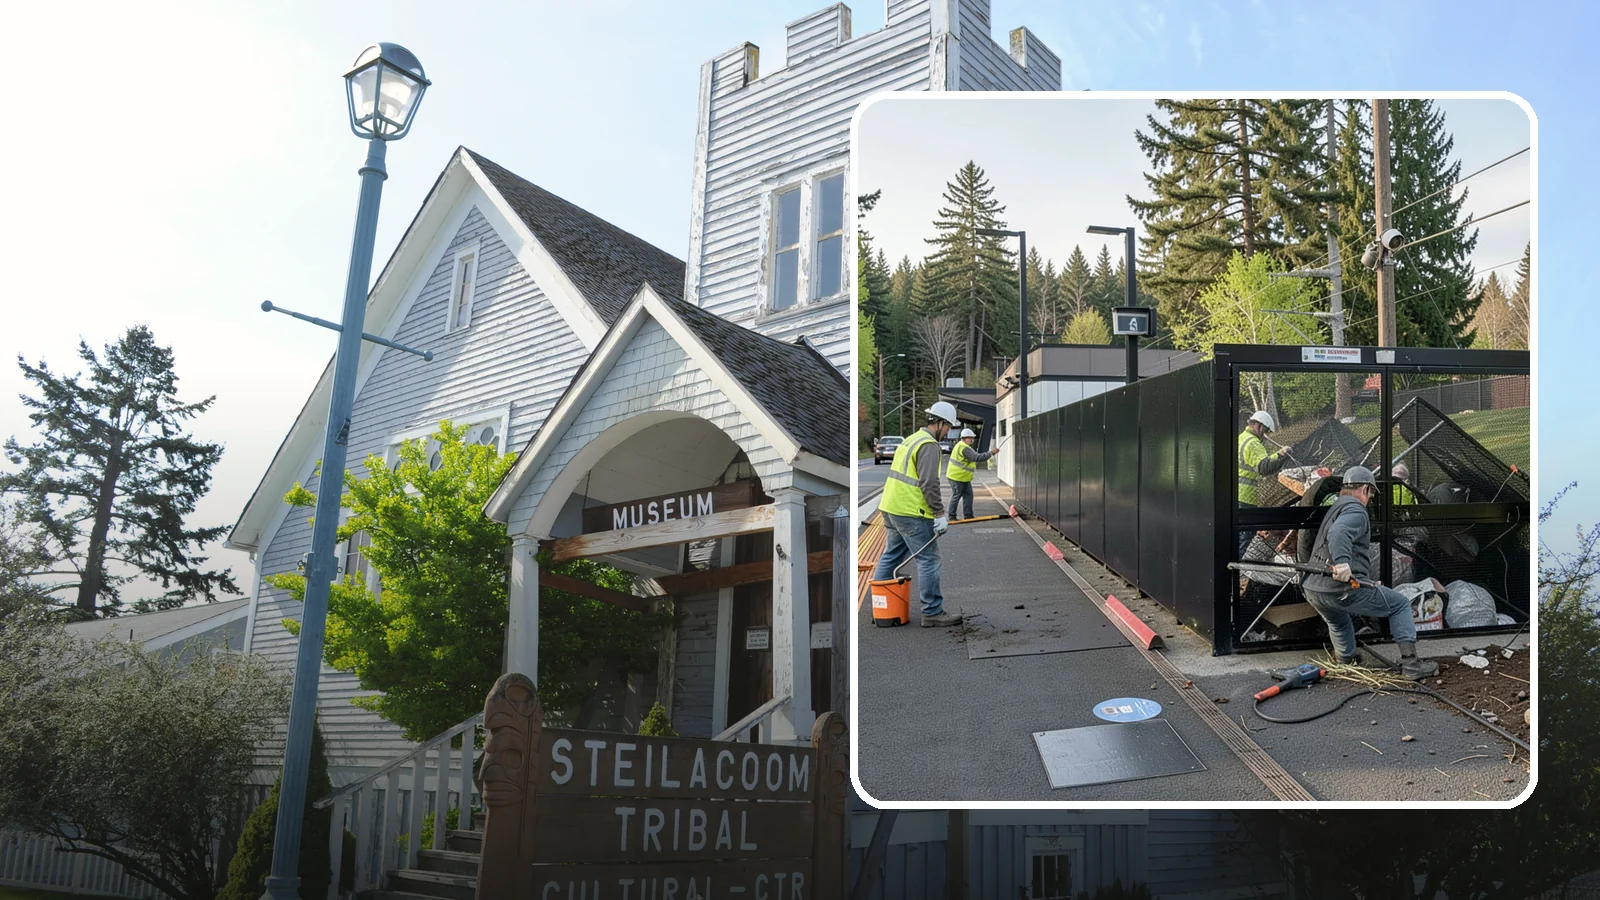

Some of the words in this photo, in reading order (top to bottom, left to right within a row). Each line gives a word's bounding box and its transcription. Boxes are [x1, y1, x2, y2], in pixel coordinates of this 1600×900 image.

[613, 491, 713, 531] MUSEUM
[551, 738, 809, 793] STEILACOOM
[615, 806, 757, 851] TRIBAL
